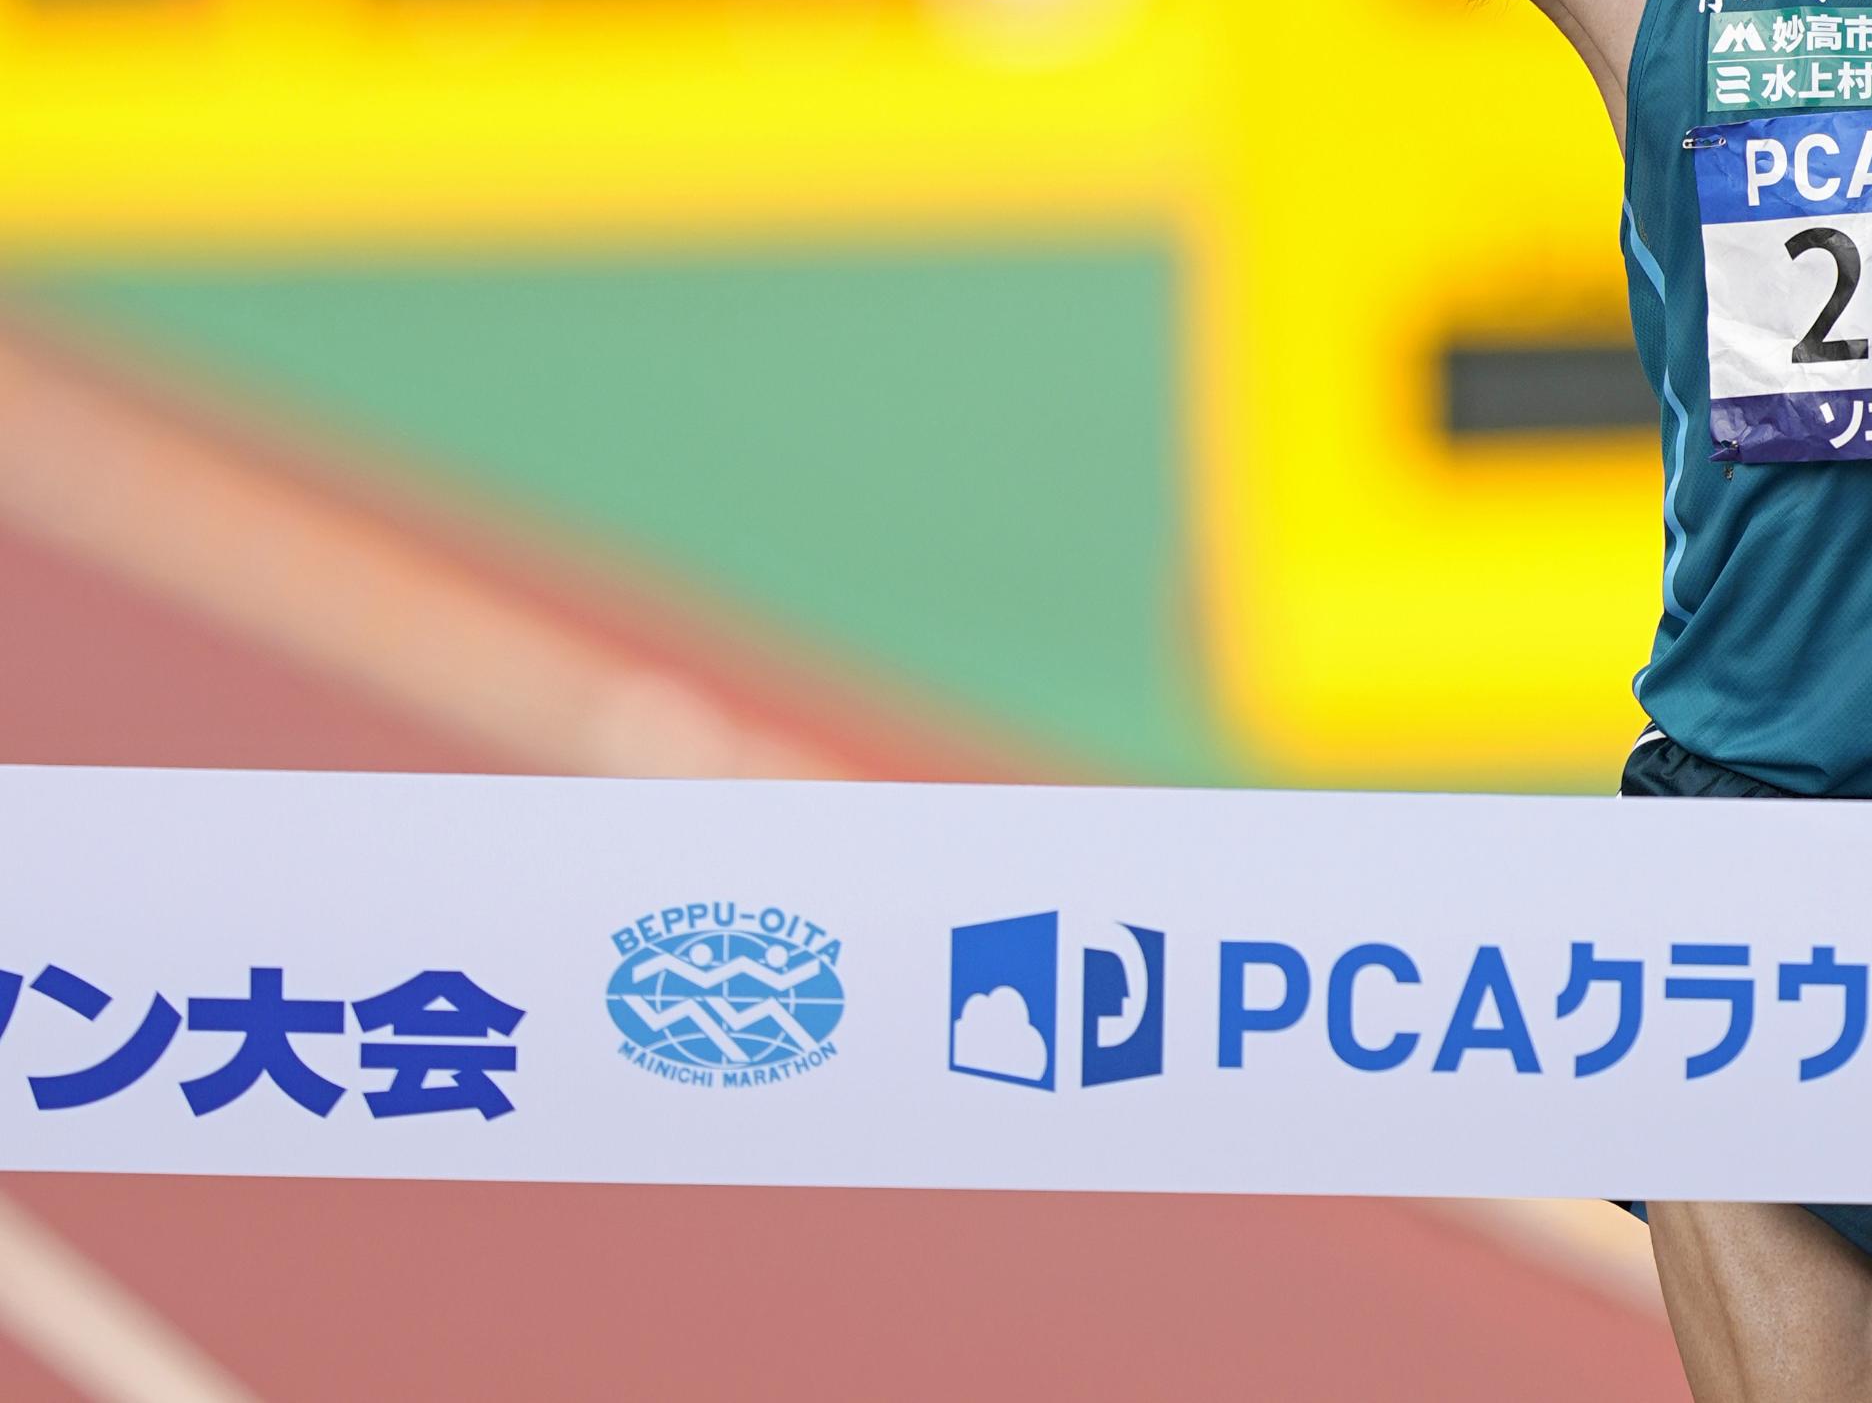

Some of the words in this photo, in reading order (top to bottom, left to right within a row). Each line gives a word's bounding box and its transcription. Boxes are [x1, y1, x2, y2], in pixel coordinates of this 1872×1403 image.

[610, 901, 842, 967] BEPPU-OITA
[617, 1040, 713, 1088] MAINICHI
[723, 1041, 838, 1089] MARATHON
